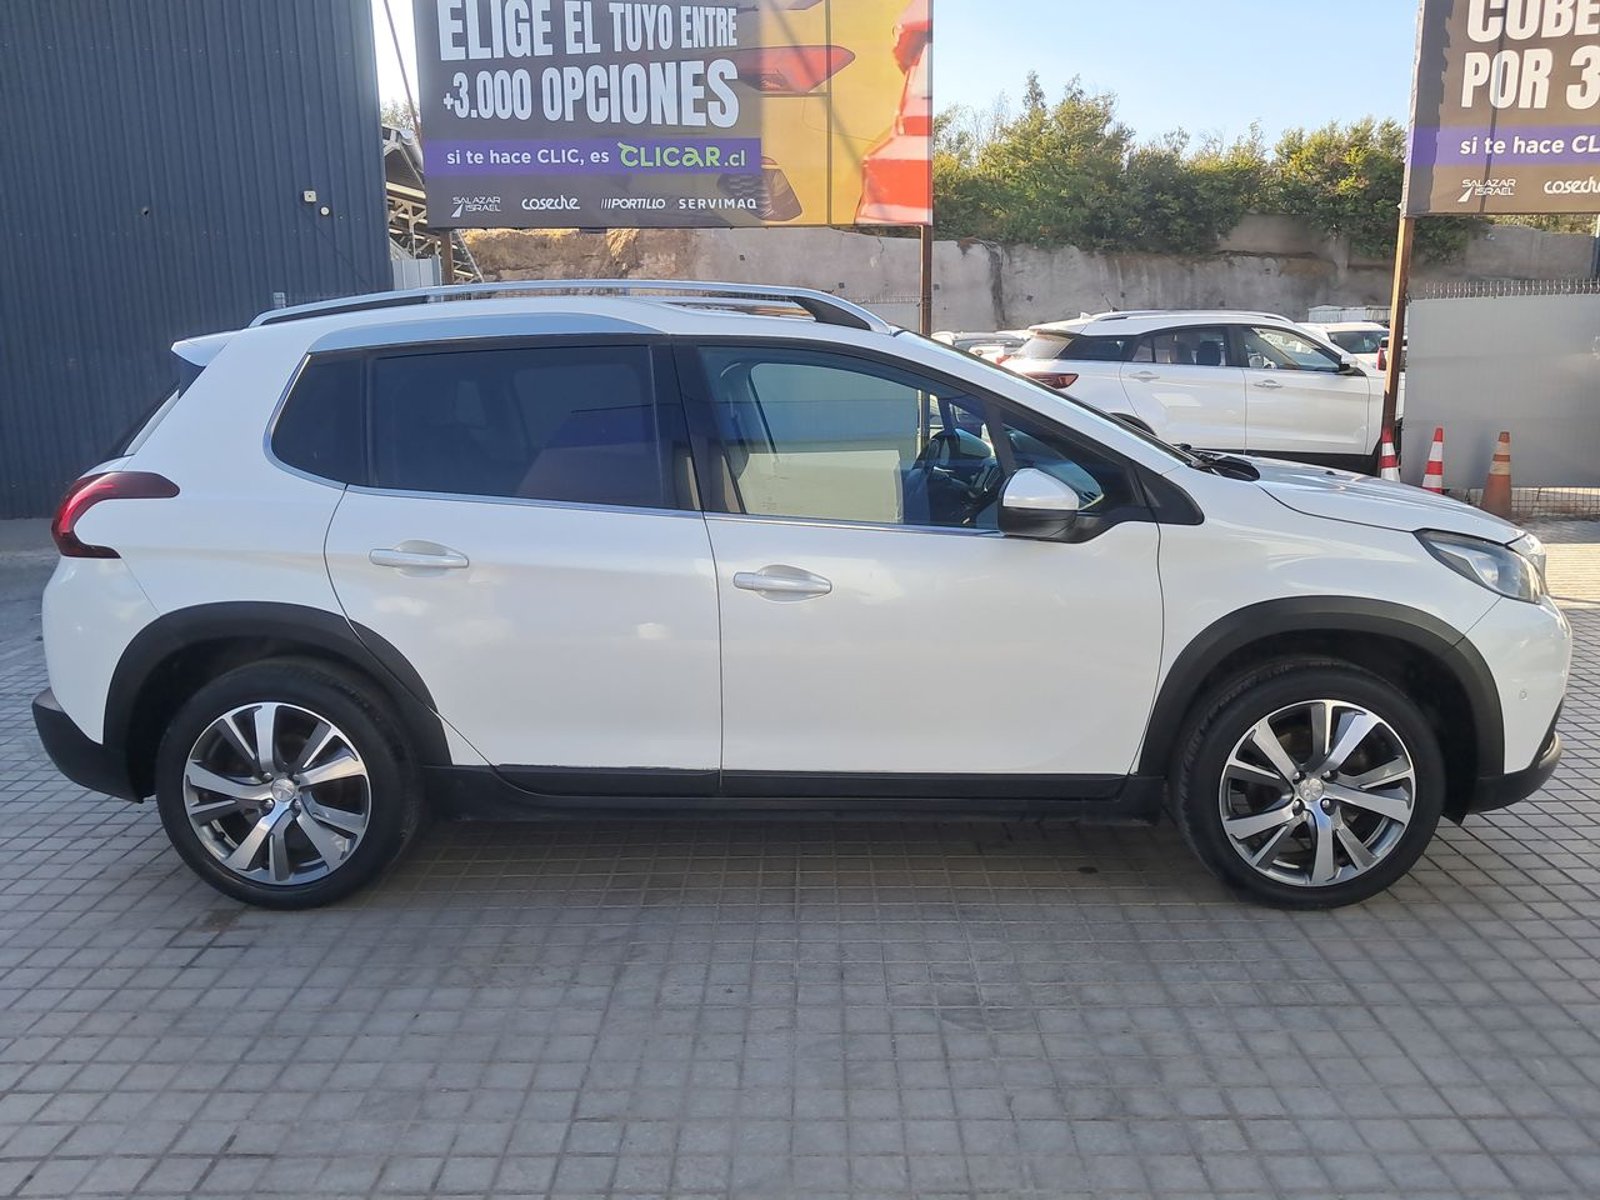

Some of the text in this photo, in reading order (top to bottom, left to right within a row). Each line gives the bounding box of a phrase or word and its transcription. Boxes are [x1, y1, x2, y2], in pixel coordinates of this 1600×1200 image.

[437, 0, 738, 61] ELIGE EL TUYO ENTRE
[1461, 48, 1553, 109] POR
[443, 58, 740, 128] +3.000 OPCIONES
[1460, 136, 1477, 155] si
[1484, 138, 1506, 155] te
[1513, 136, 1565, 155] hace
[446, 149, 461, 165] si
[466, 150, 484, 164] te
[489, 149, 531, 164] hace
[537, 149, 585, 166] CLIC,
[590, 150, 610, 164] es
[1461, 178, 1517, 187] SALAZAR
[1474, 186, 1515, 196] ISRAEL
[452, 196, 501, 205] SALAZAR
[678, 198, 758, 210] SERVIMAQ
